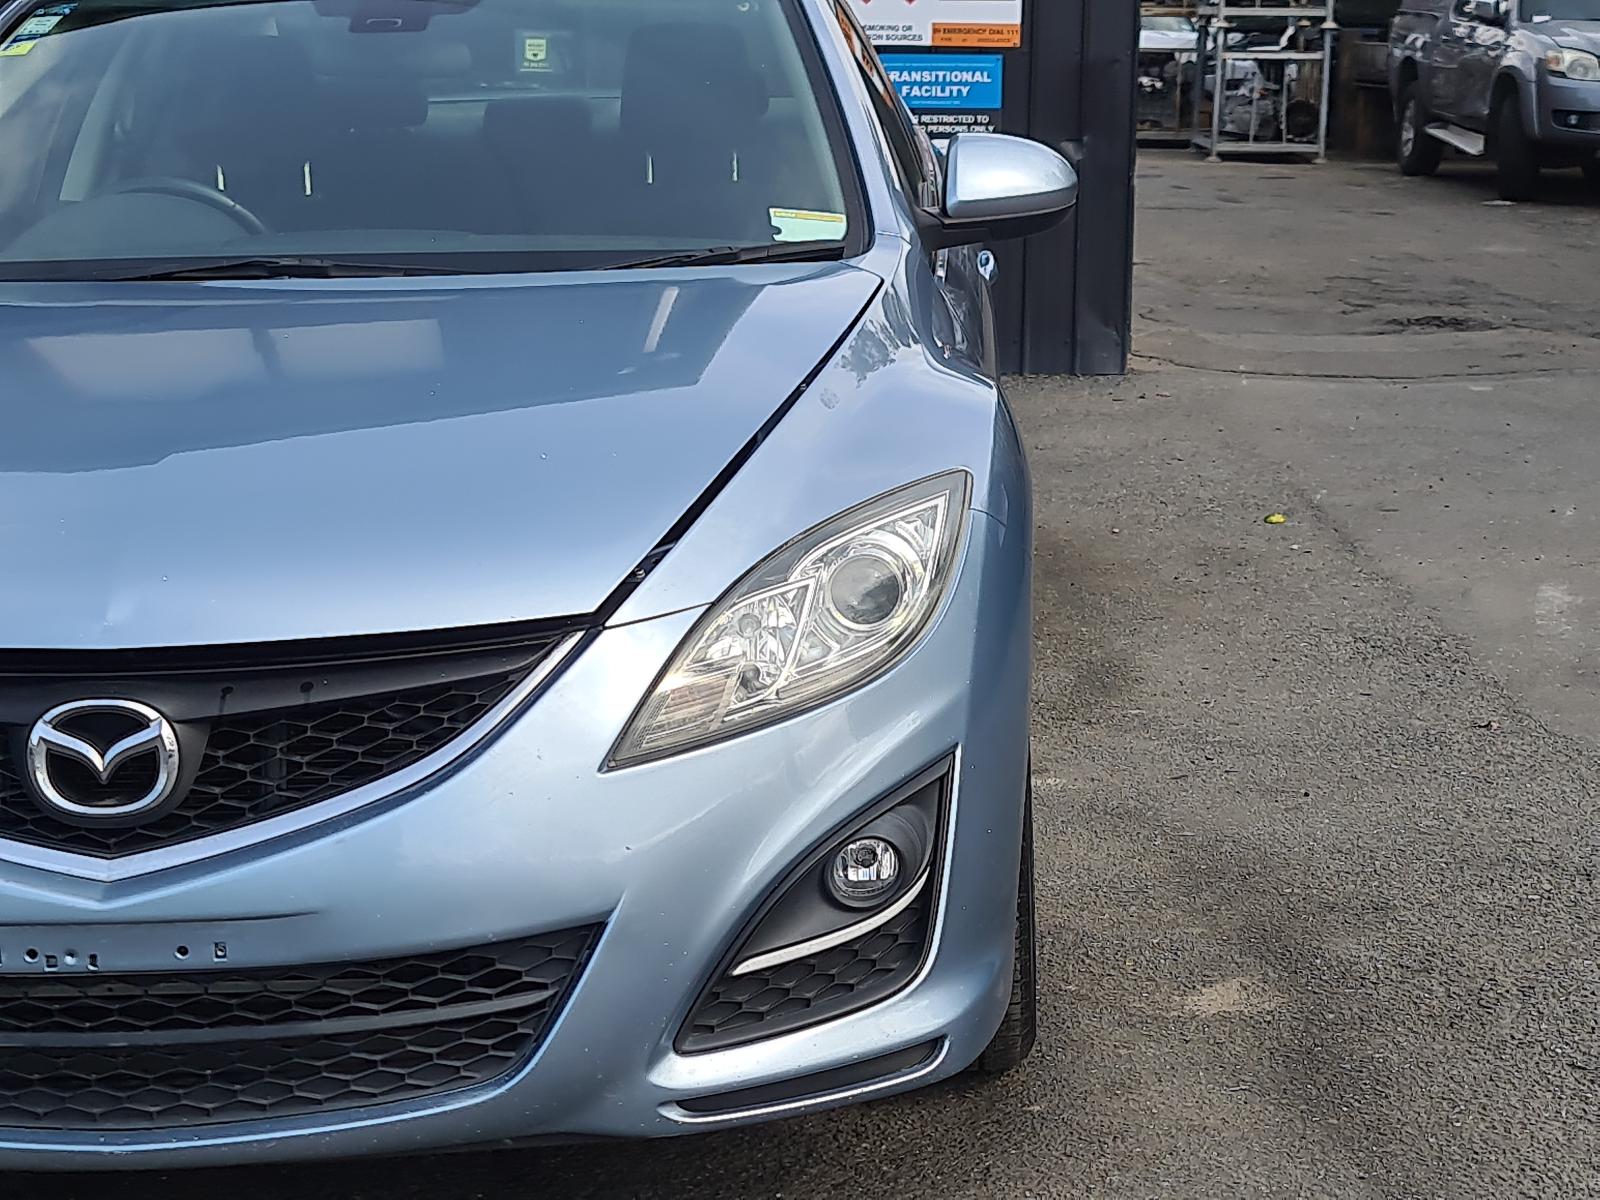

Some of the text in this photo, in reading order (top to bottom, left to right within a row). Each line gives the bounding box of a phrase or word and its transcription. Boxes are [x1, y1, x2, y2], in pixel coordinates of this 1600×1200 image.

[901, 24, 913, 32] OR
[901, 85, 971, 97] FACILITY
[920, 114, 975, 123] RESTRICTED
[976, 115, 989, 123] TO
[927, 125, 969, 133] PERSONS
